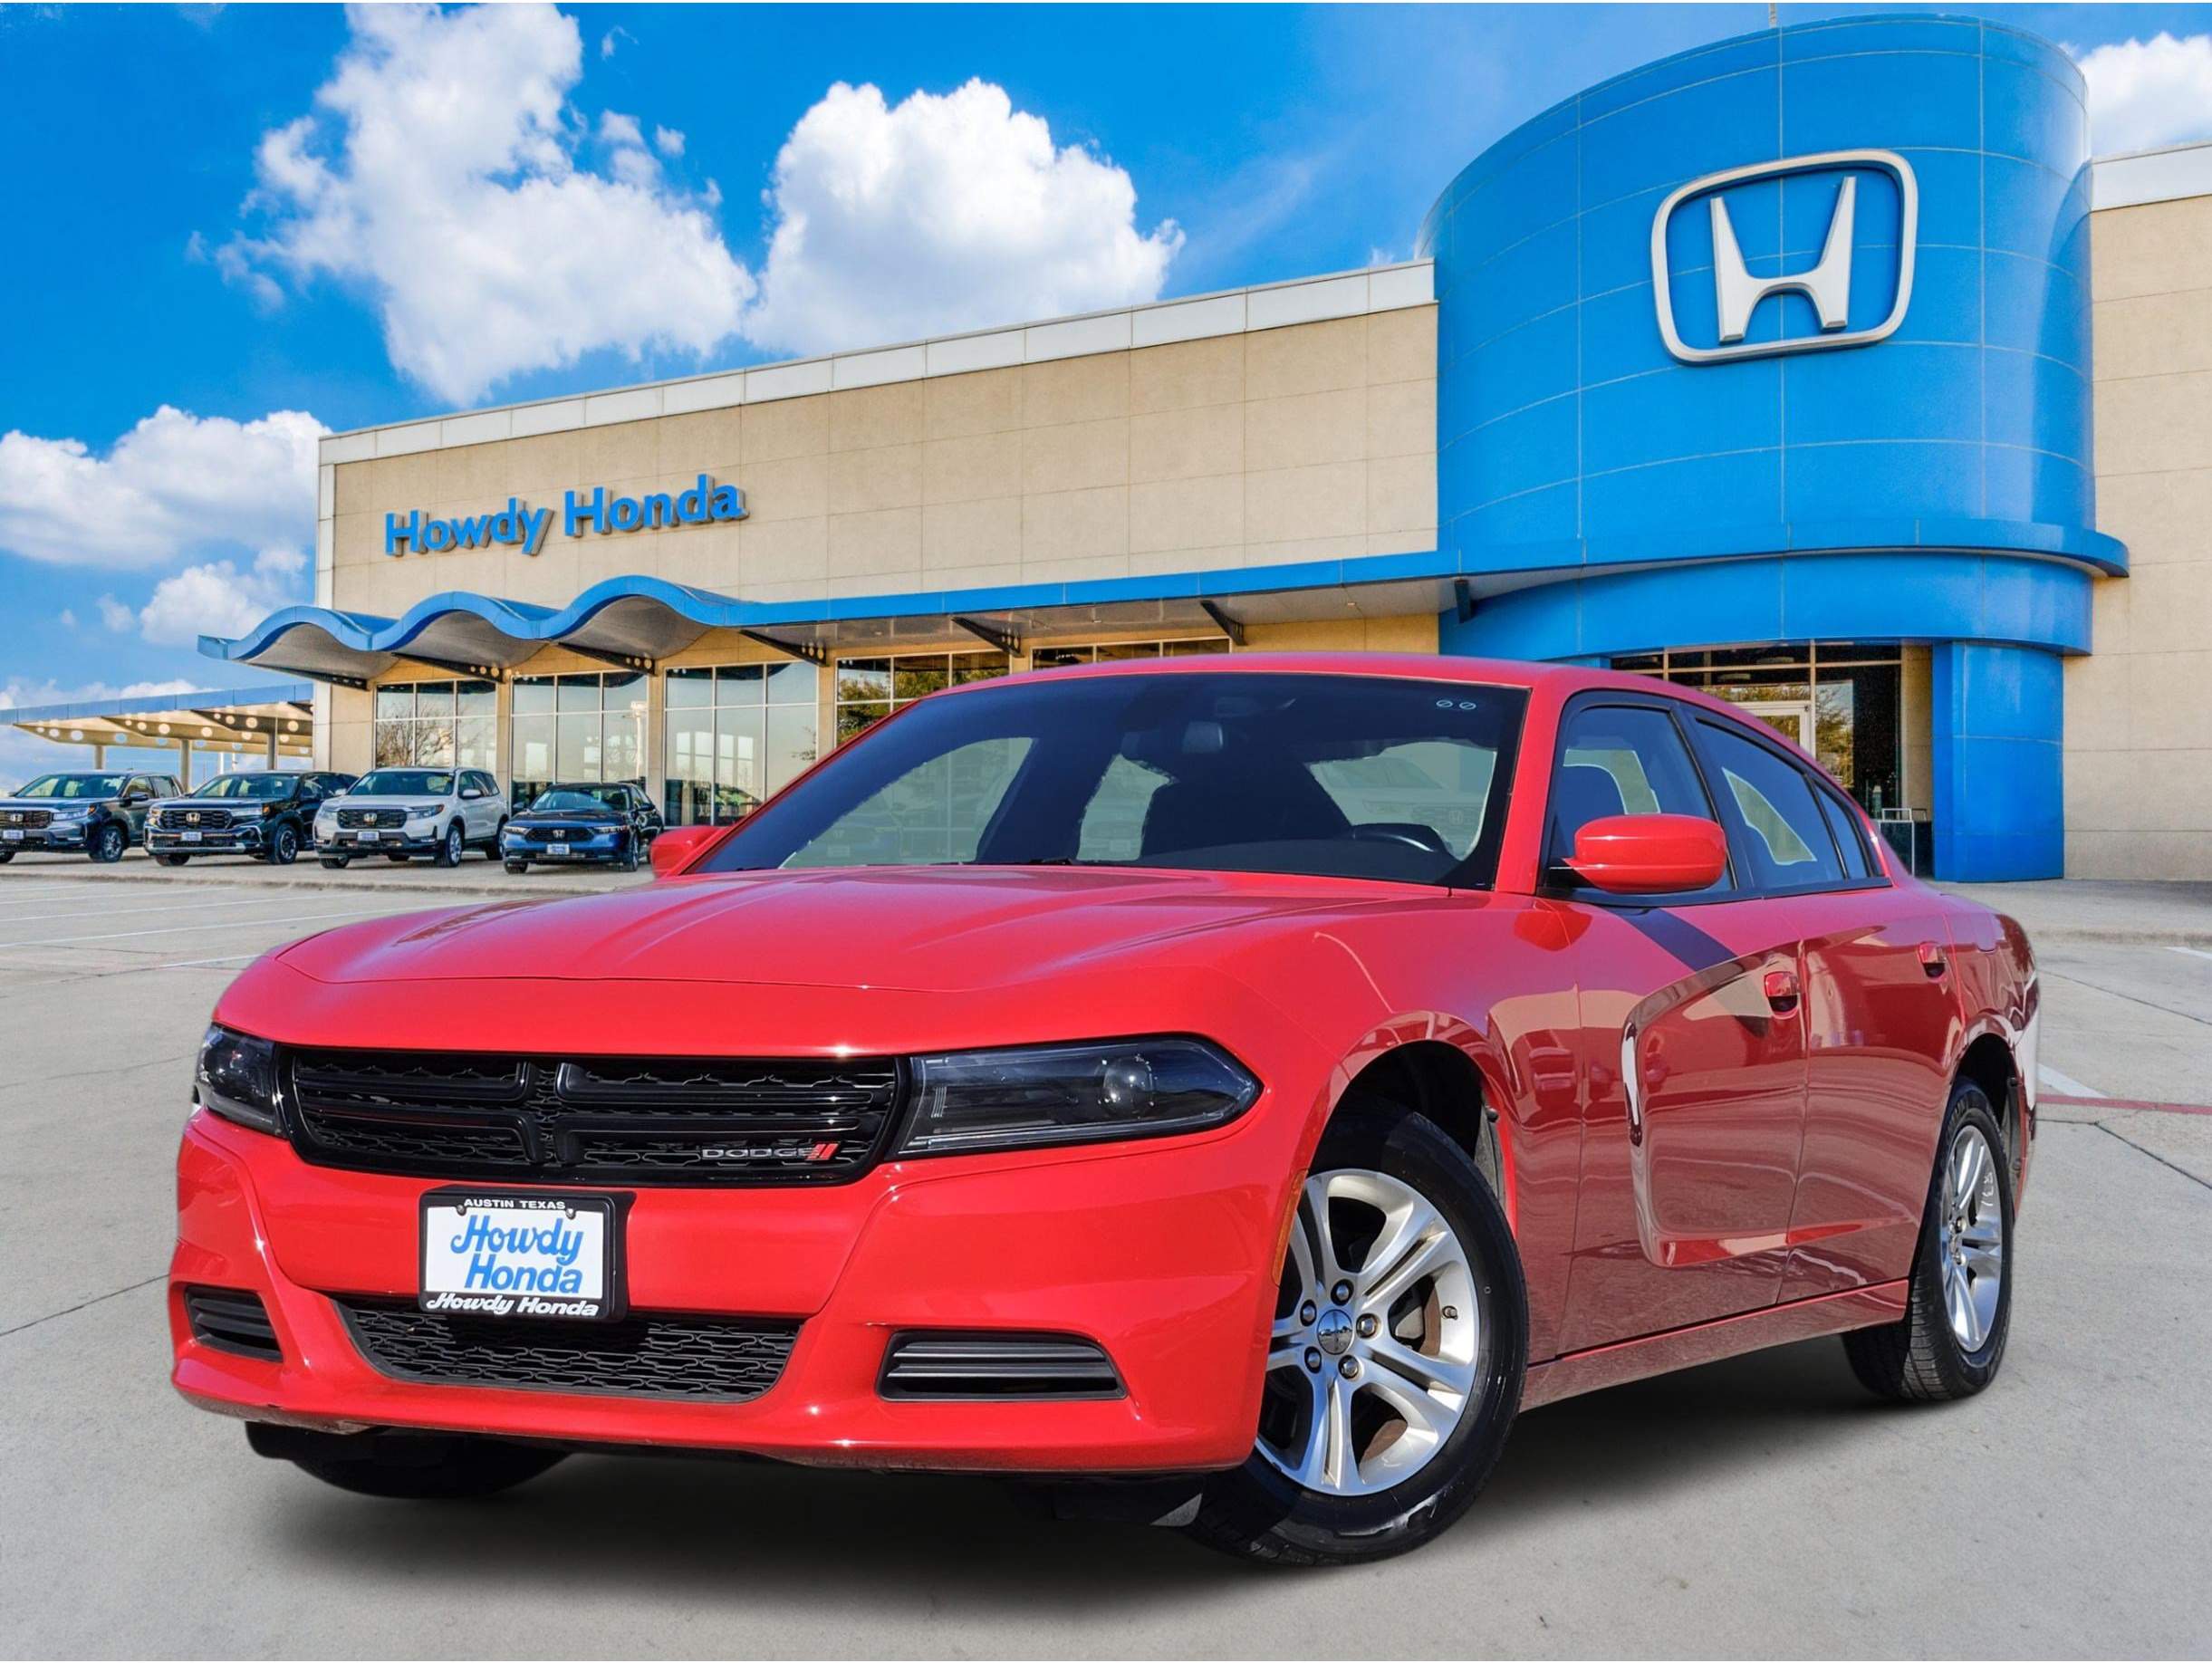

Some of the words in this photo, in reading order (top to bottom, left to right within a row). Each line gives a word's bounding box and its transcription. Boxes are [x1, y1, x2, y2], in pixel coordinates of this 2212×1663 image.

[385, 497, 553, 556] Howdy
[564, 474, 748, 537] Honda
[702, 1148, 819, 1159] DODGE
[464, 1198, 515, 1208] AUSTIN
[519, 1200, 566, 1210] TEXAS
[450, 1215, 584, 1266] Howdy
[464, 1254, 583, 1293] Honda
[427, 1293, 515, 1315] Howdy
[516, 1296, 600, 1316] Honda
